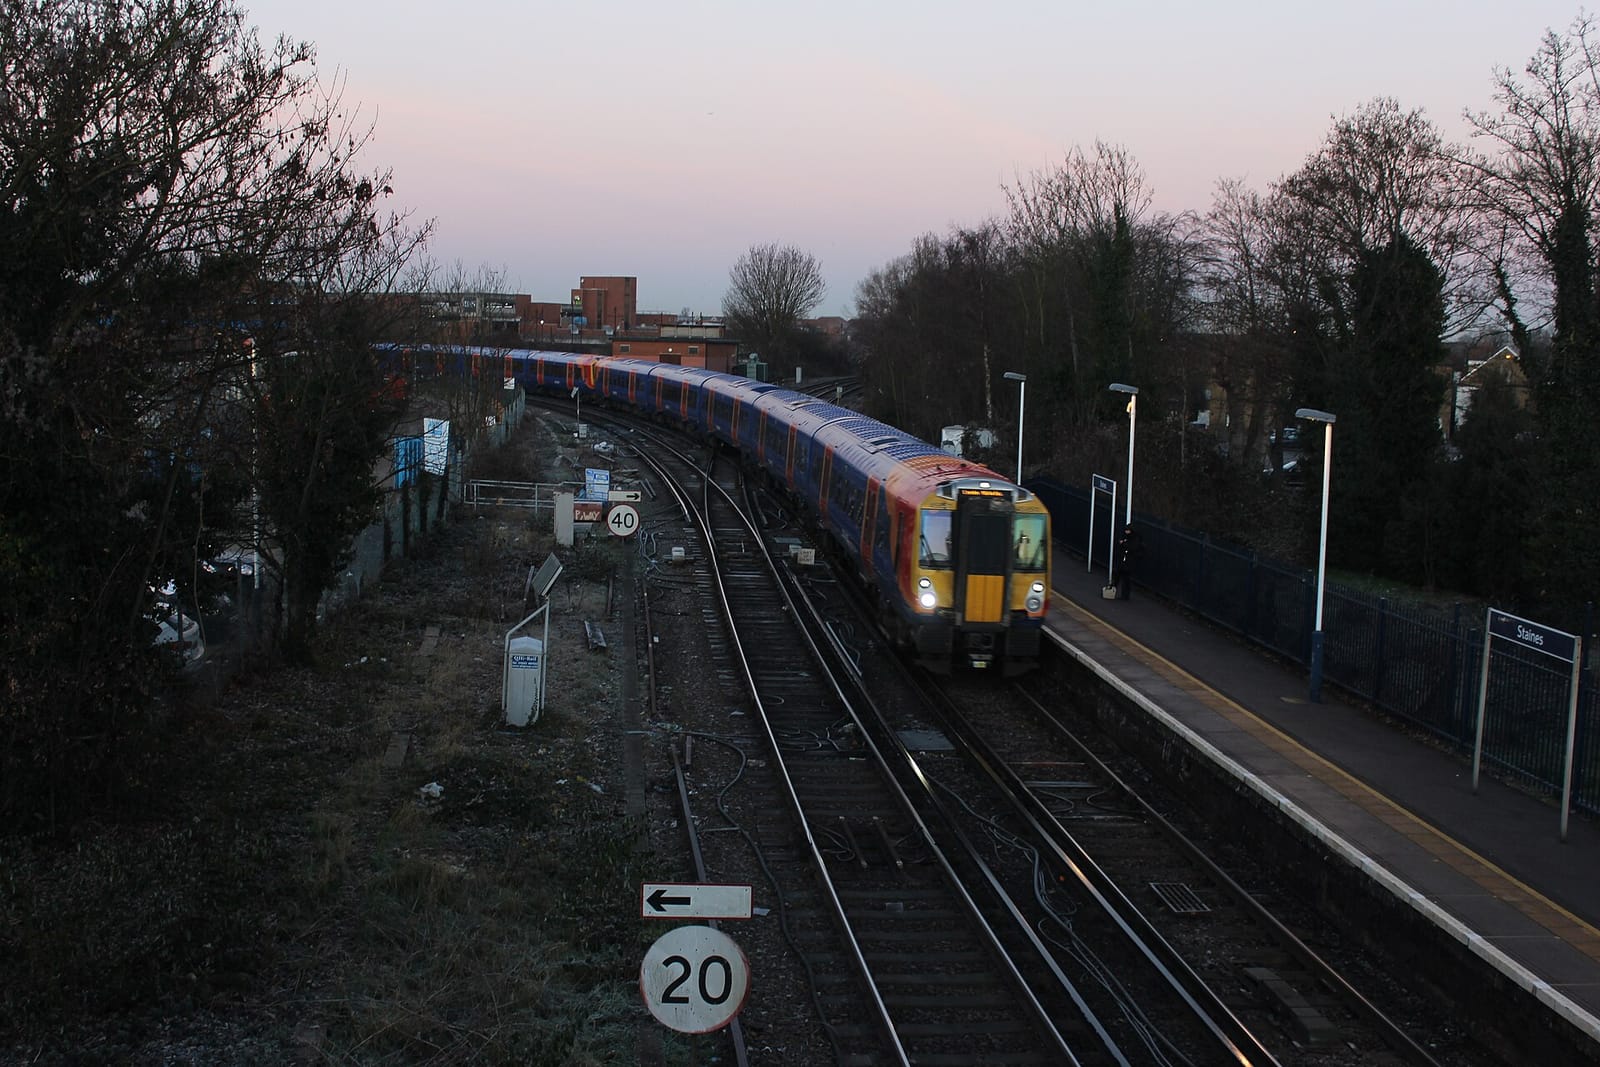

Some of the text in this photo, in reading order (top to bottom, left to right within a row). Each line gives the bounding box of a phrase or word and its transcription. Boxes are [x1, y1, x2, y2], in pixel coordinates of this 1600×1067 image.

[611, 512, 634, 528] 40
[1517, 624, 1544, 646] Staines
[661, 955, 733, 1005] 20
